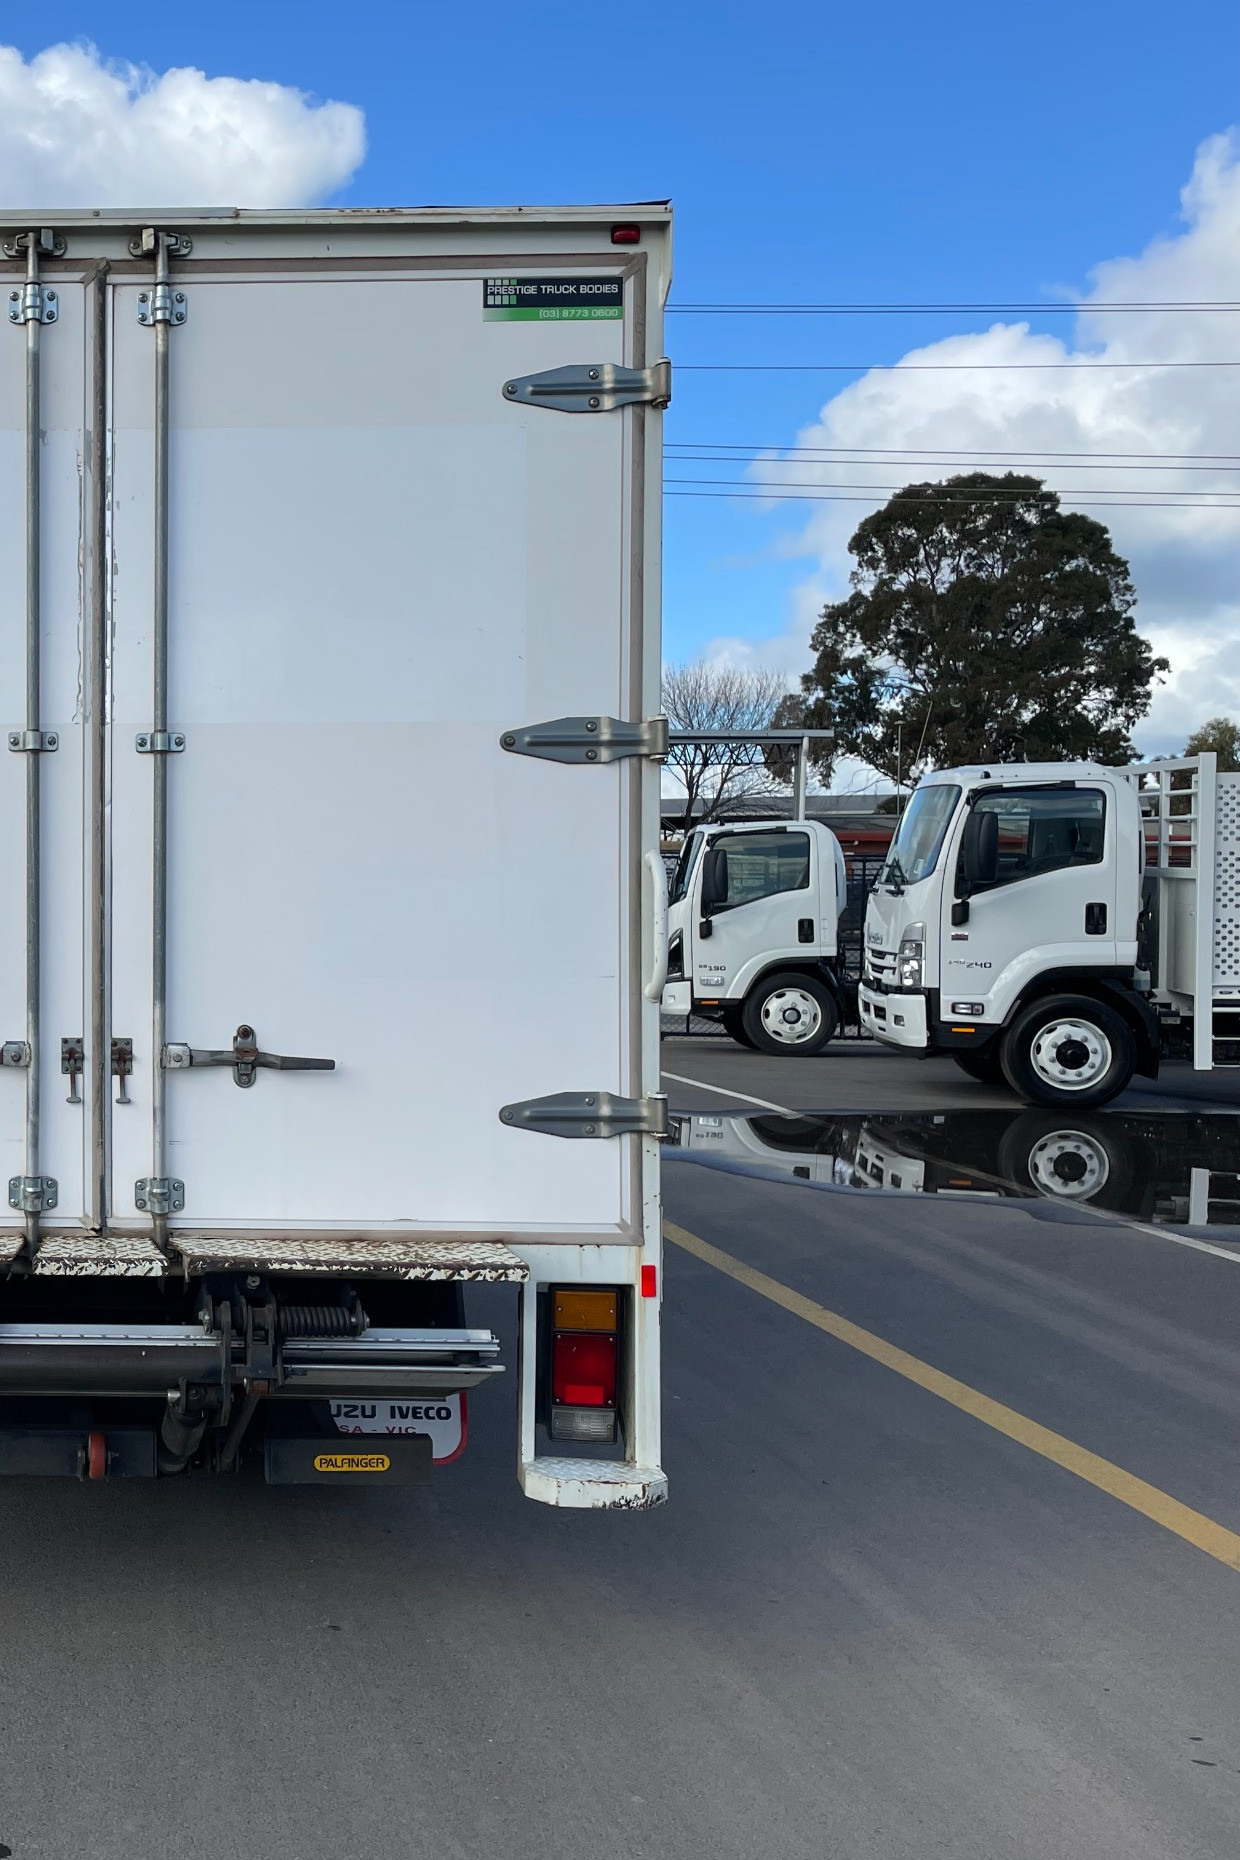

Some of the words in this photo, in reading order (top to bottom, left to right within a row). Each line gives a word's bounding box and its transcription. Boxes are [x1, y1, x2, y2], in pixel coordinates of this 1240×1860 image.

[487, 285, 538, 295] PRESTIGE
[540, 284, 577, 294] TRUCK
[579, 284, 618, 294] BODIES
[539, 309, 559, 319] (03)
[562, 309, 589, 318] 8773
[390, 1405, 452, 1421] IVECO
[319, 1457, 385, 1469] PALFINGER
